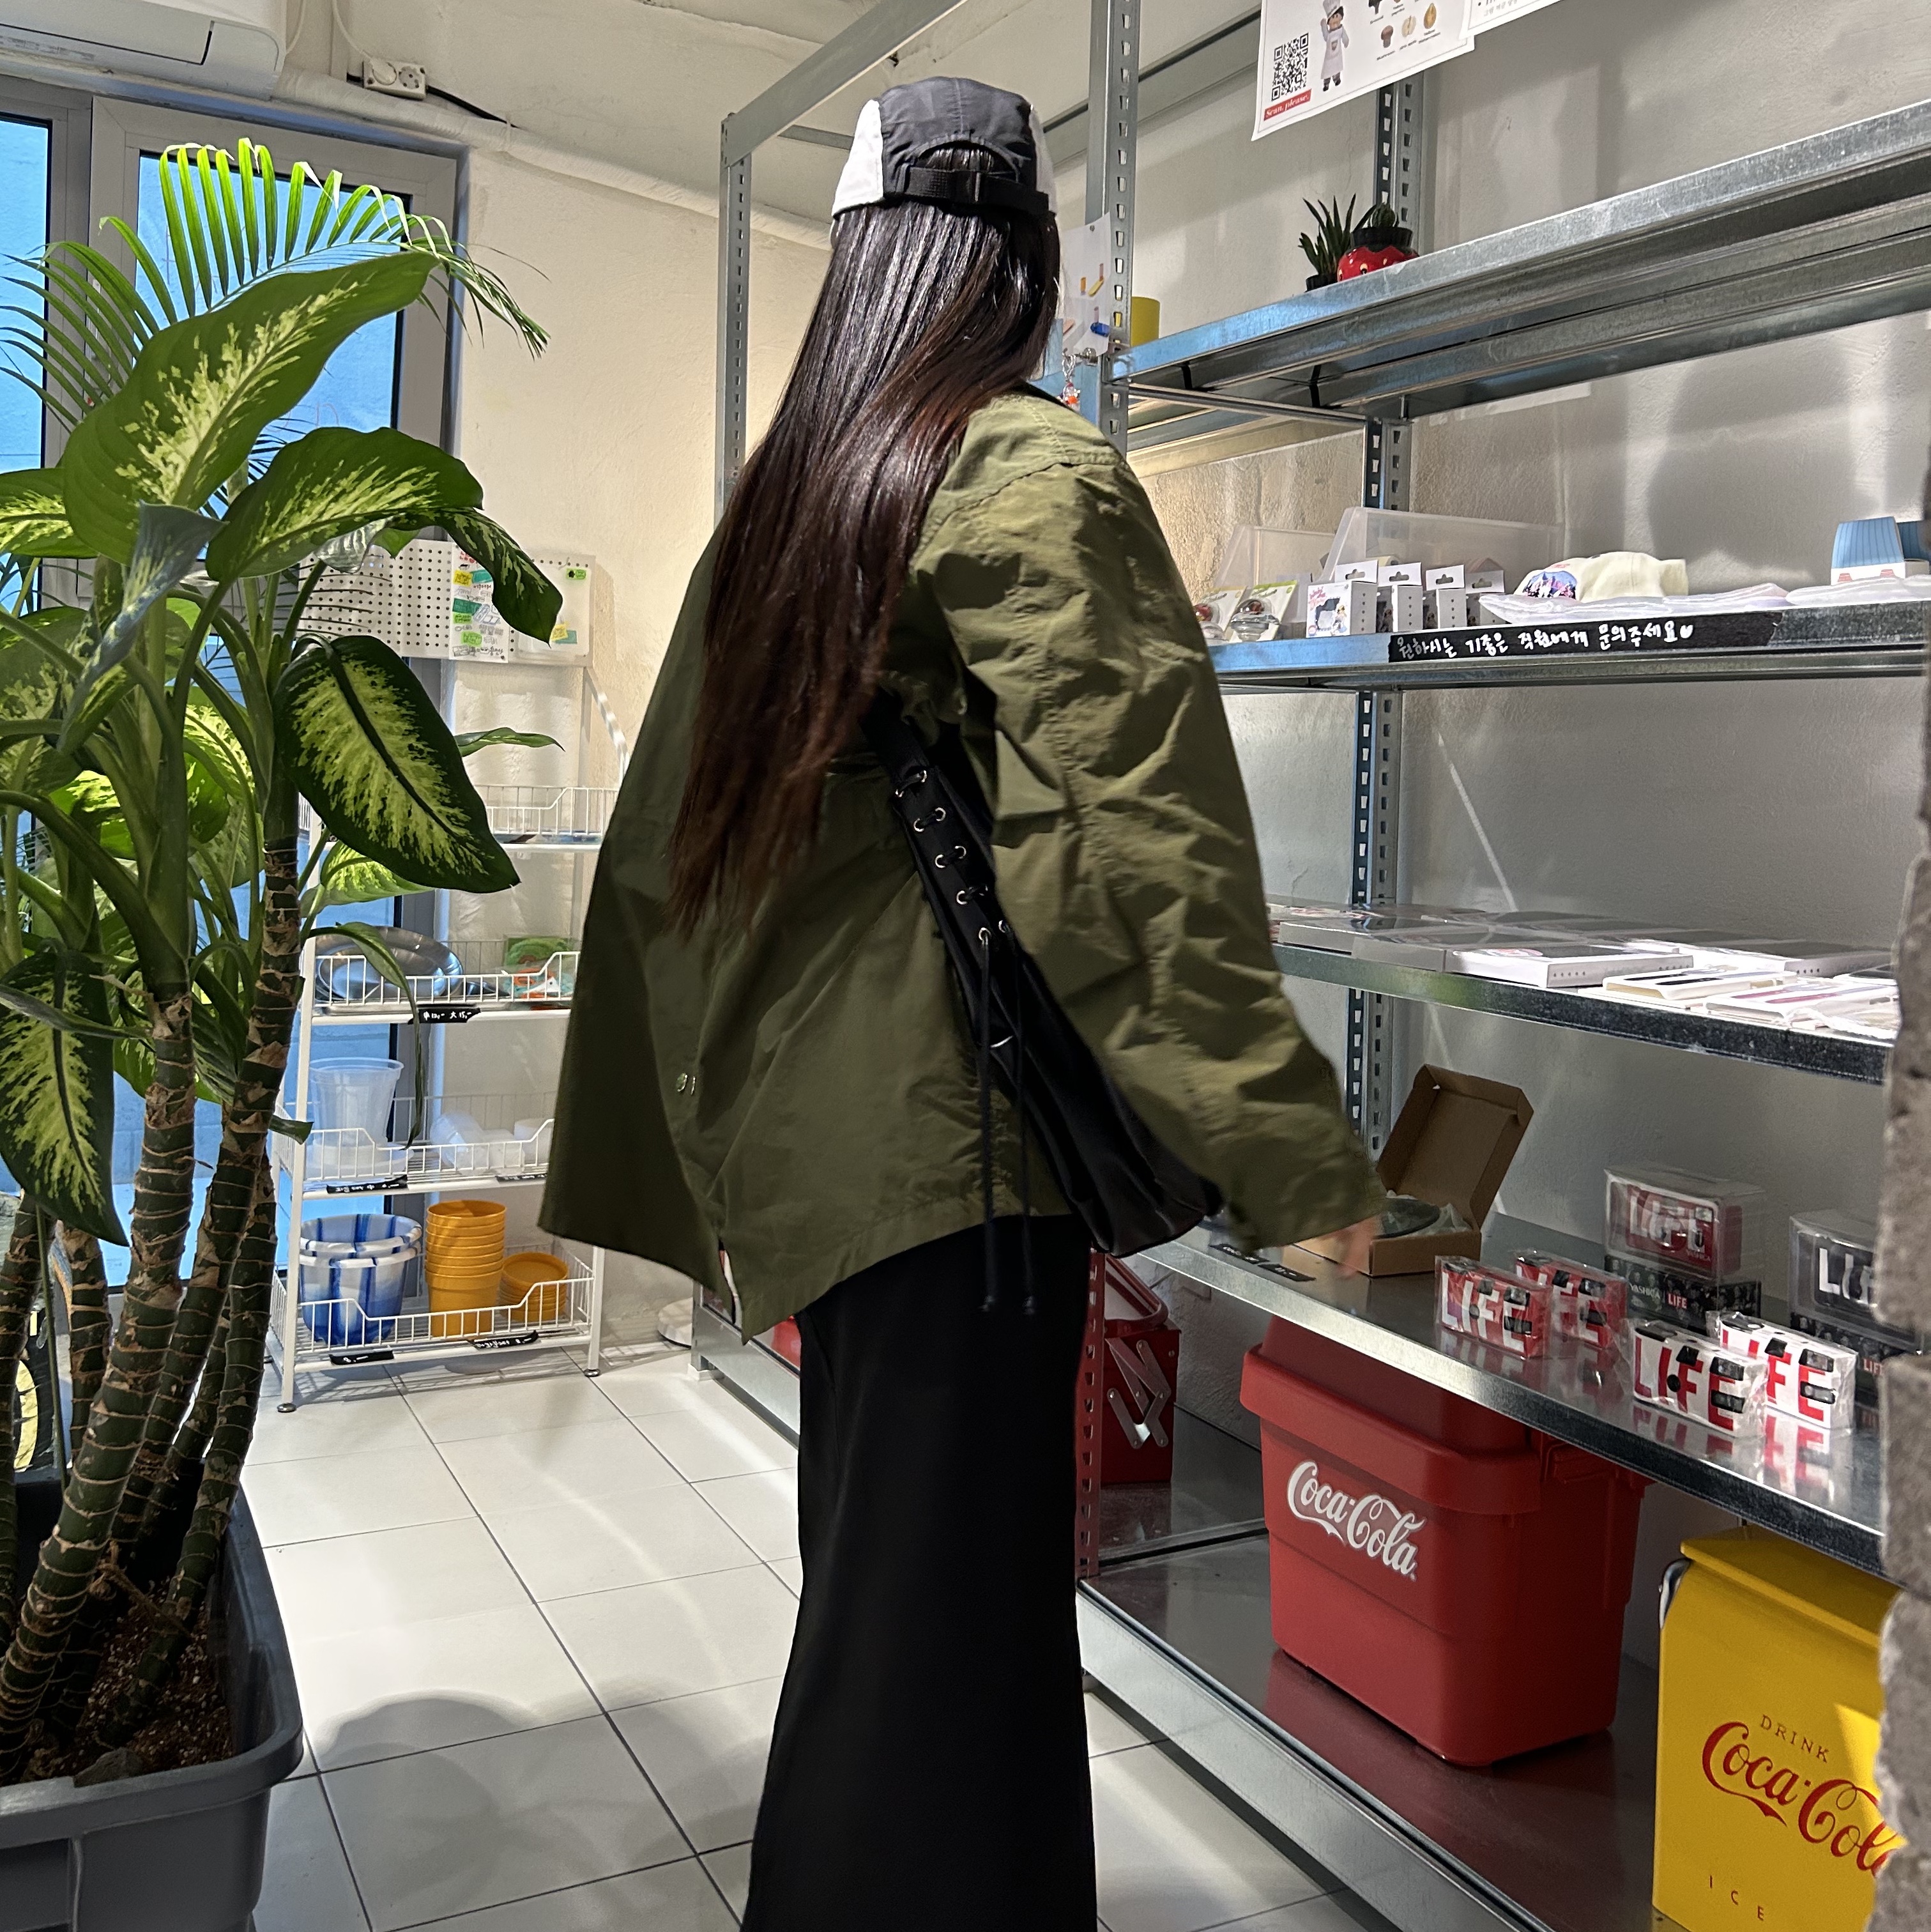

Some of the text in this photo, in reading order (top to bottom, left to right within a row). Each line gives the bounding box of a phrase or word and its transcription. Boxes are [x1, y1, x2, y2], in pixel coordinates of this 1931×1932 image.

[1397, 620, 1678, 659] 원하시는 기종은 직원에게 문의주세요
[1442, 1271, 1526, 1353] LIFE
[1630, 1284, 1688, 1309] YASHICA LIFE
[1635, 1336, 1736, 1431] LIFE
[1288, 1460, 1426, 1575] Coca-Cola
[1760, 1714, 1829, 1763] DRINK
[1709, 1874, 1764, 1921] ICE
